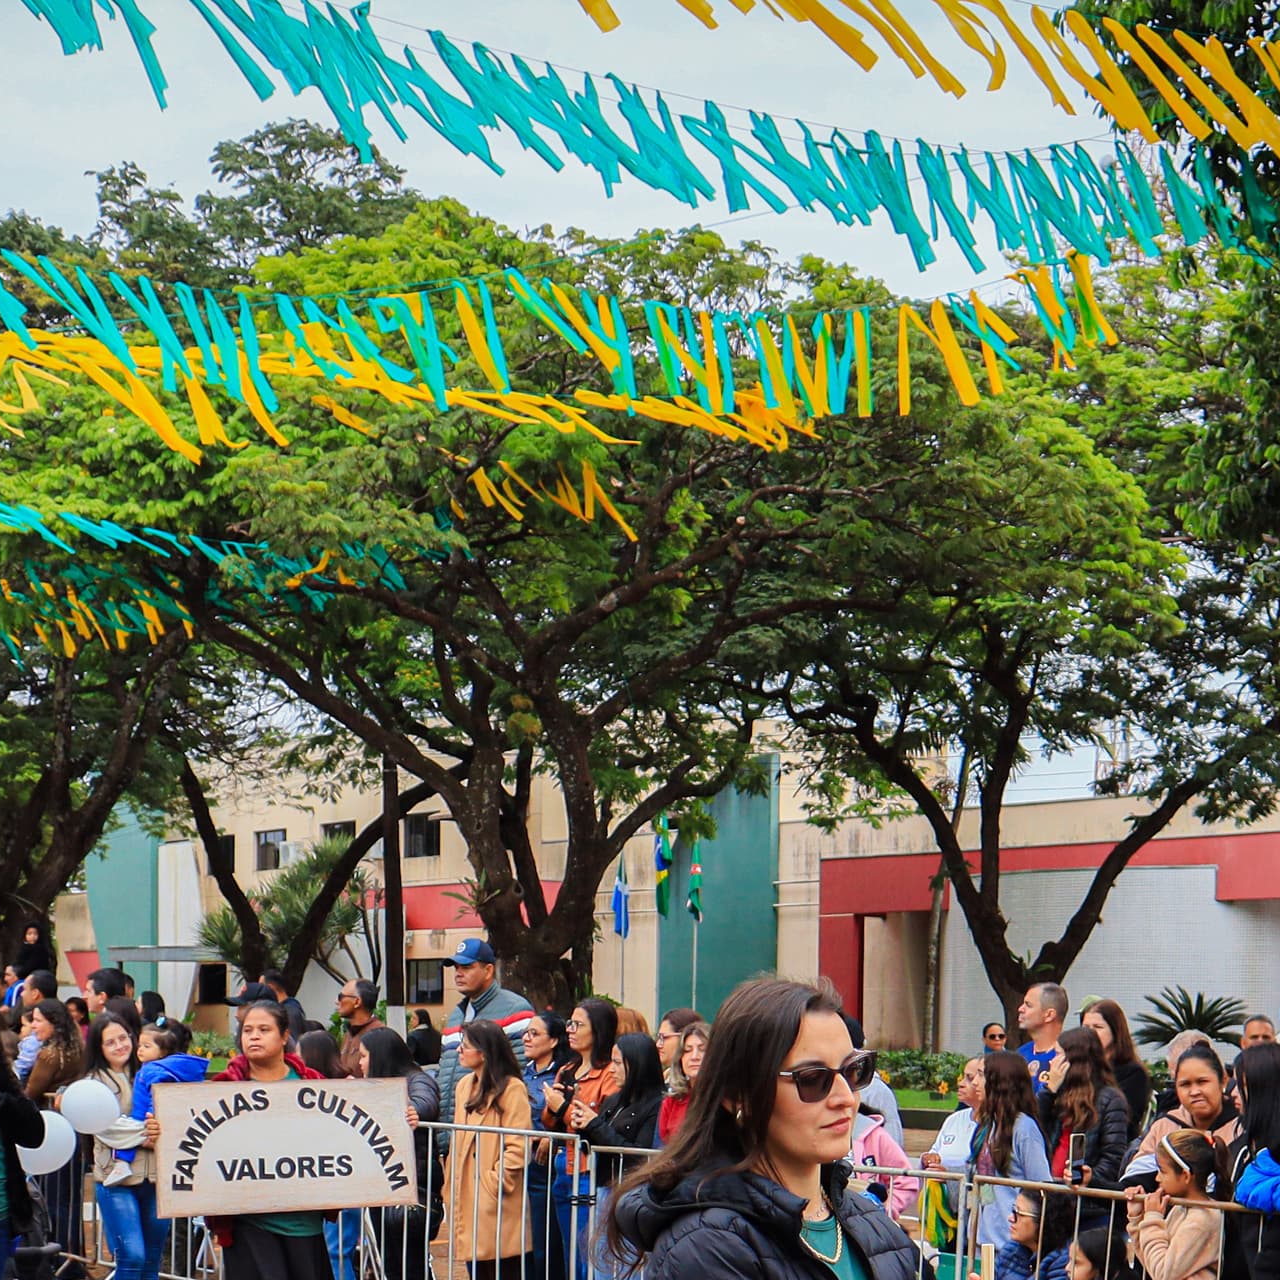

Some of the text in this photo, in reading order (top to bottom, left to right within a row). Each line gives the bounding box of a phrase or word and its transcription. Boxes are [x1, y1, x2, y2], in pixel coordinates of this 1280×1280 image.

[172, 1087, 409, 1192] FAMÍLIAS CULTIVAM
[217, 1154, 353, 1181] VALORES
